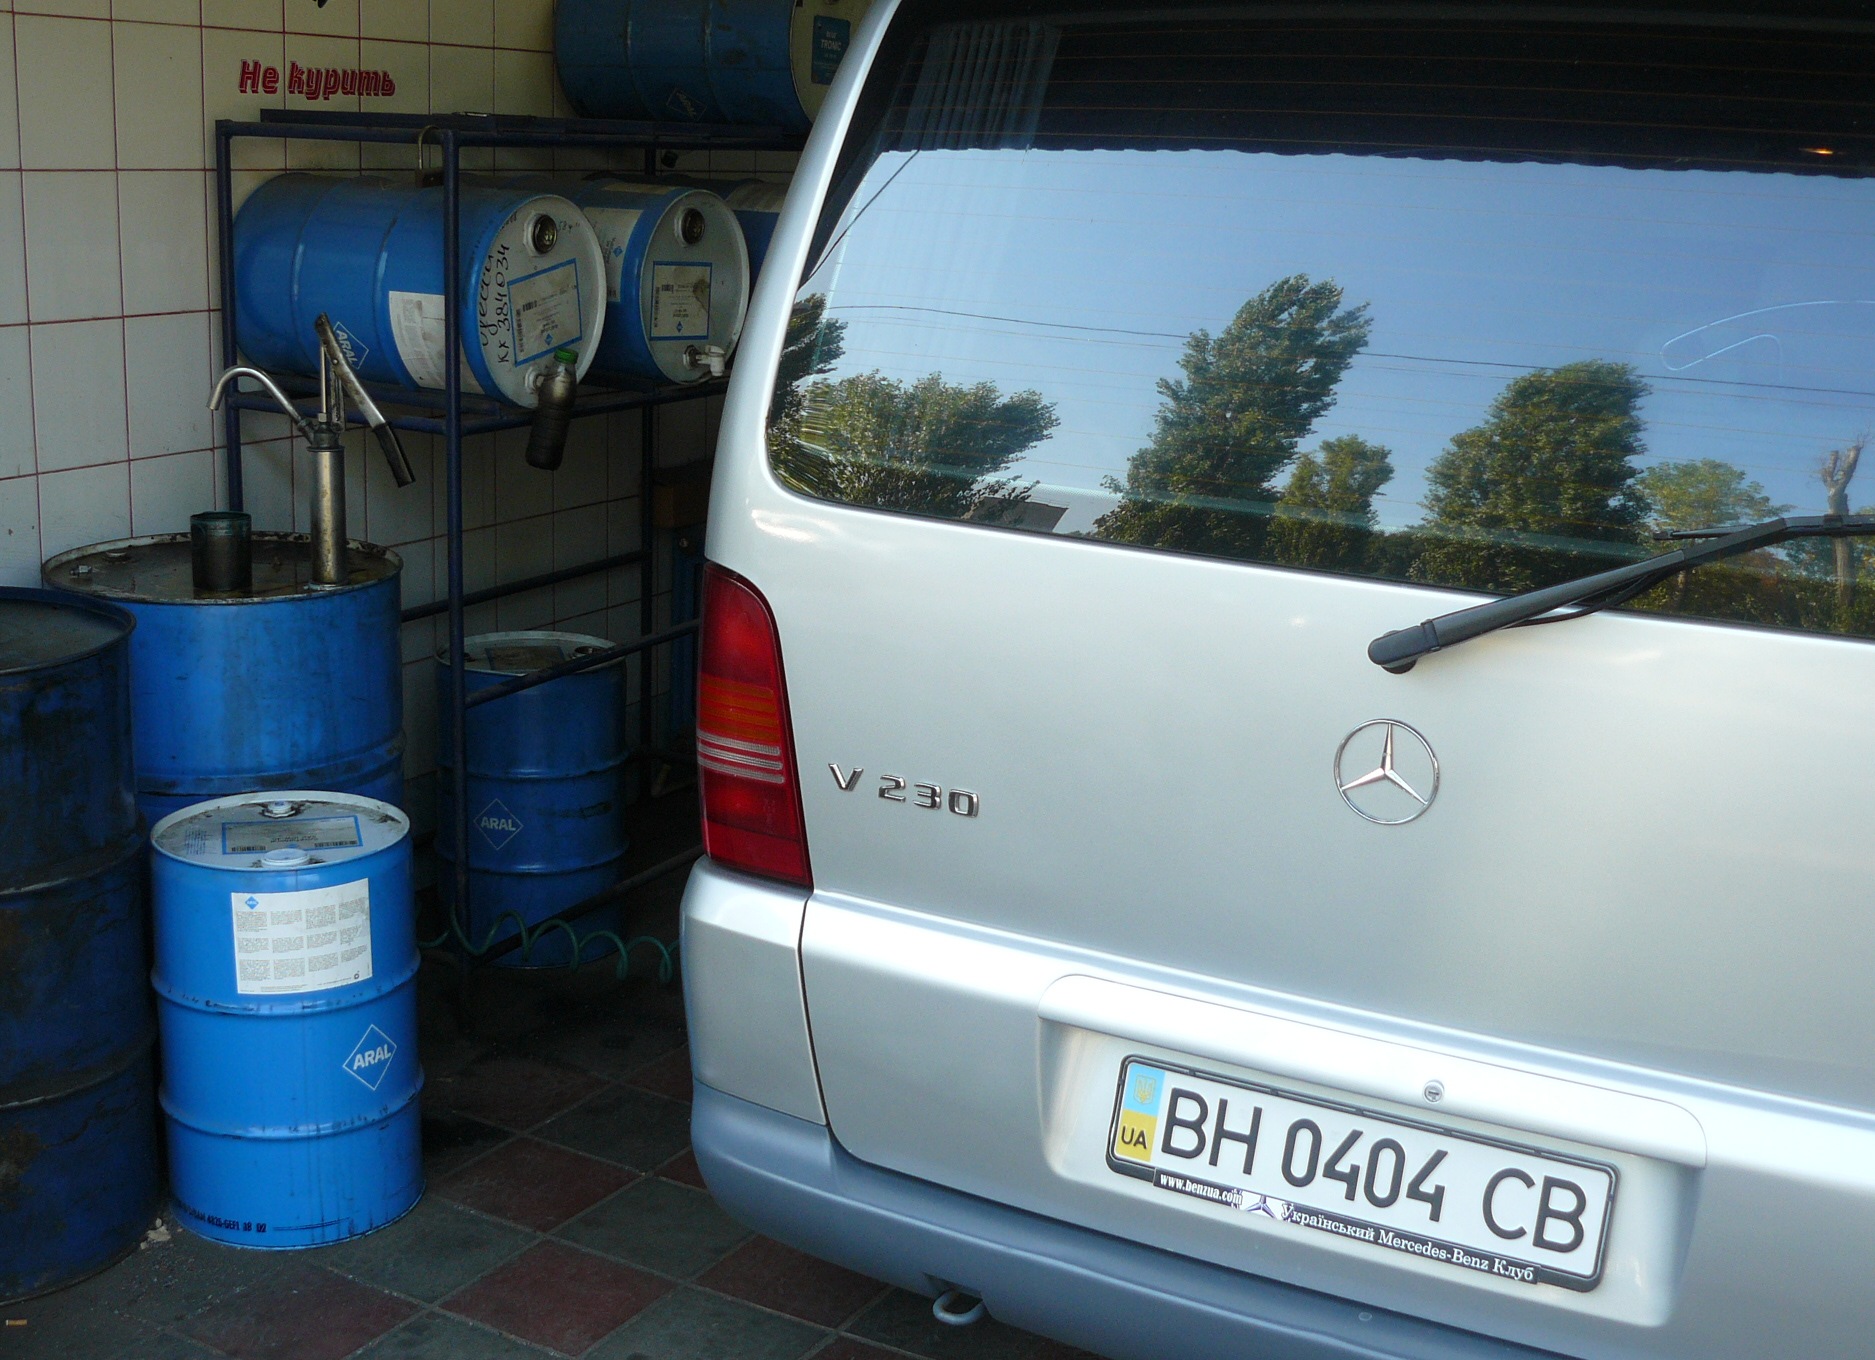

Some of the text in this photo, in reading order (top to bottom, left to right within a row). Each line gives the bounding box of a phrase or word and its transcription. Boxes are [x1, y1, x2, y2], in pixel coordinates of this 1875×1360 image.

[239, 59, 395, 101] Не курить
[336, 329, 358, 364] ARAL
[828, 763, 980, 818] V 230
[481, 816, 517, 832] ARAL
[353, 1043, 392, 1071] ARAL
[1120, 1125, 1148, 1150] UA
[1161, 1087, 1587, 1253] BH 0404 CB
[1160, 1173, 1243, 1205] www.benzua.com
[1281, 1202, 1535, 1282] Український Mercedes-Benz Клуб
